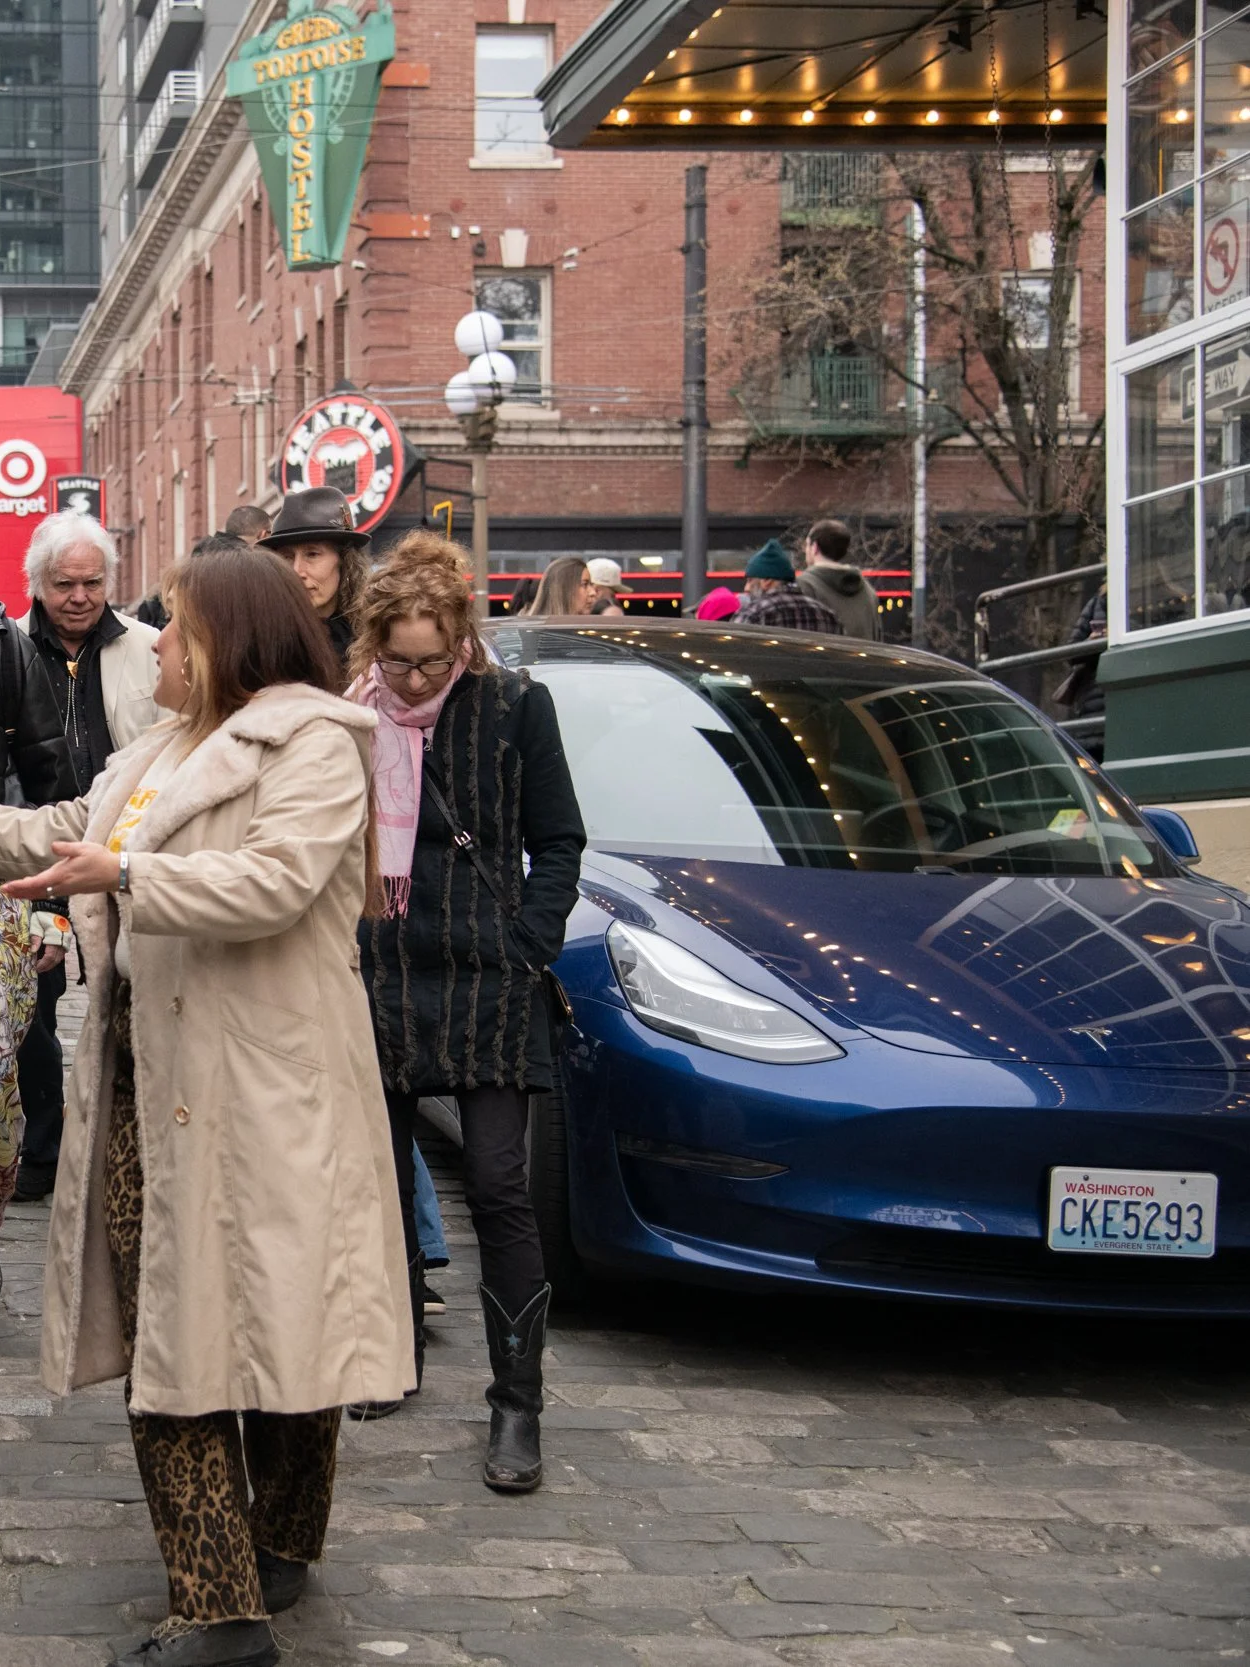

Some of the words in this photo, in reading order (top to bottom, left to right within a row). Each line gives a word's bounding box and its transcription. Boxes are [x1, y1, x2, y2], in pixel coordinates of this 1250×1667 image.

[277, 17, 340, 49] GREEN
[254, 36, 366, 84] TORTOISE
[289, 77, 315, 262] HOSTEL
[1214, 363, 1237, 390] WAY
[286, 402, 392, 466] SEATTLE
[57, 479, 100, 491] SEATTLE
[1065, 1182, 1154, 1197] WASHINGTON
[1060, 1197, 1203, 1242] CKE5293
[1093, 1241, 1142, 1250] EVERGREEN
[1146, 1243, 1172, 1251] STATE
